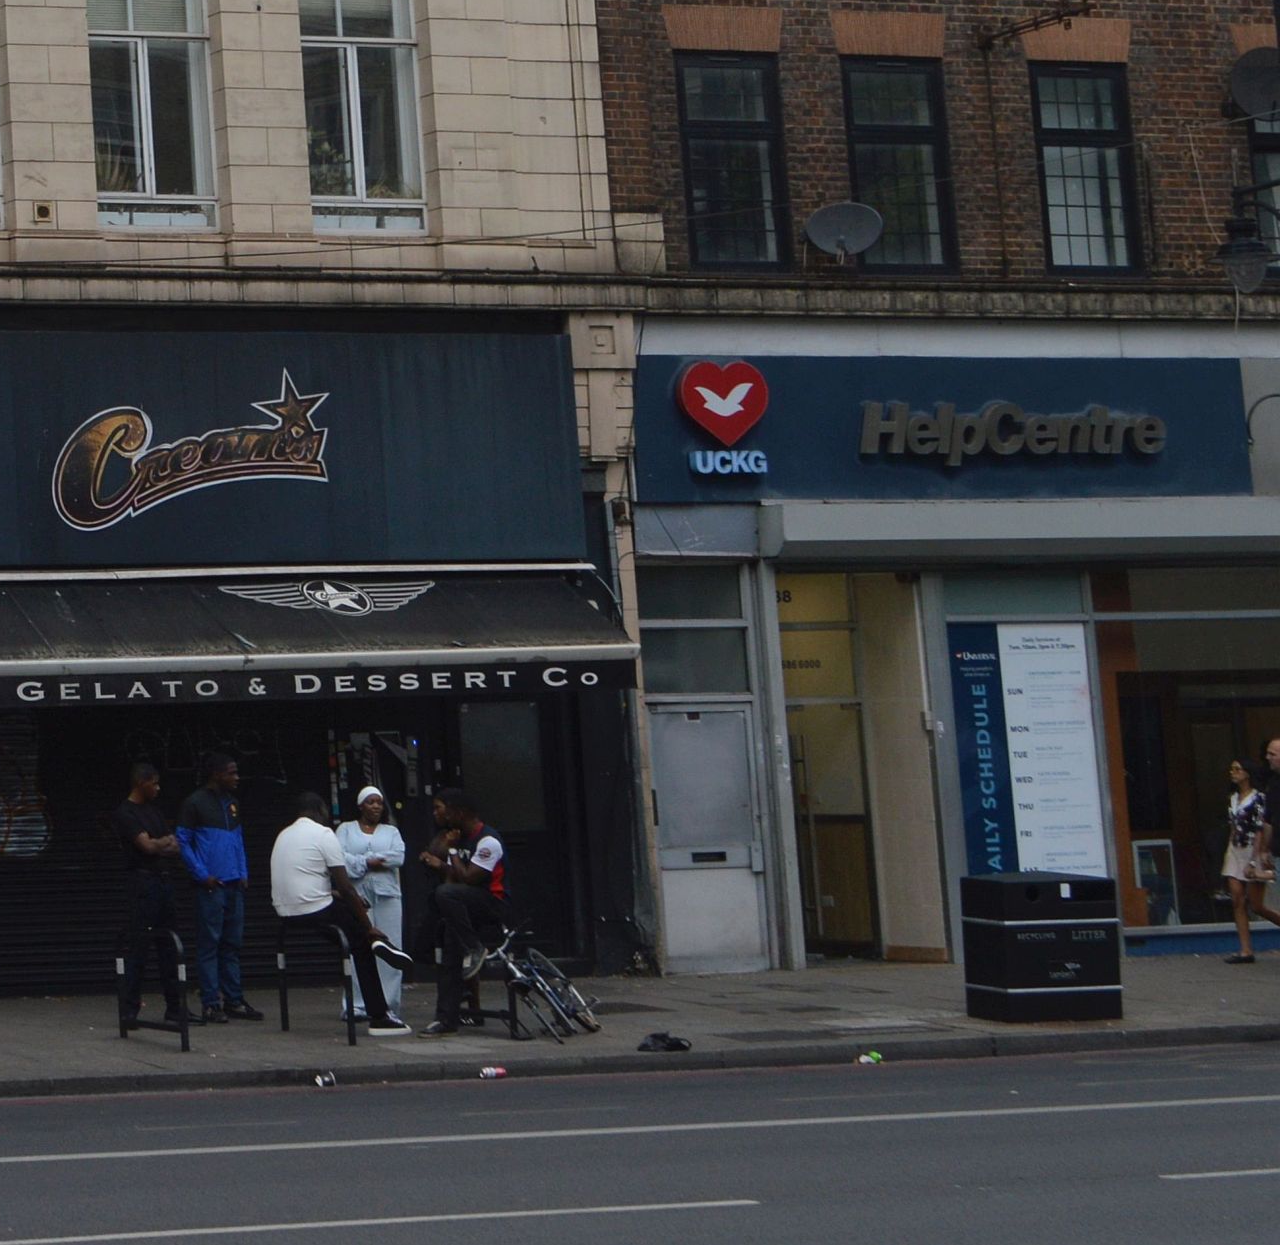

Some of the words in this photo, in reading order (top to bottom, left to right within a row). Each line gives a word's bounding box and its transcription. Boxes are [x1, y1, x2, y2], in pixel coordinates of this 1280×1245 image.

[860, 402, 1167, 466] HelpCentre
[52, 406, 329, 531] Creams
[693, 450, 768, 474] UCKG
[16, 678, 219, 702] GELATO
[248, 677, 267, 696] &
[294, 670, 517, 695] DESSERT
[542, 666, 599, 688] Co
[1007, 688, 1023, 696] SUN
[1010, 725, 1030, 733] MON
[971, 683, 998, 809] SCHEDULE
[1013, 751, 1028, 759] TUE
[1015, 776, 1033, 784] WED
[1020, 830, 1032, 838] FRI
[985, 818, 1005, 875] AILY
[1071, 930, 1107, 940] LITTER
